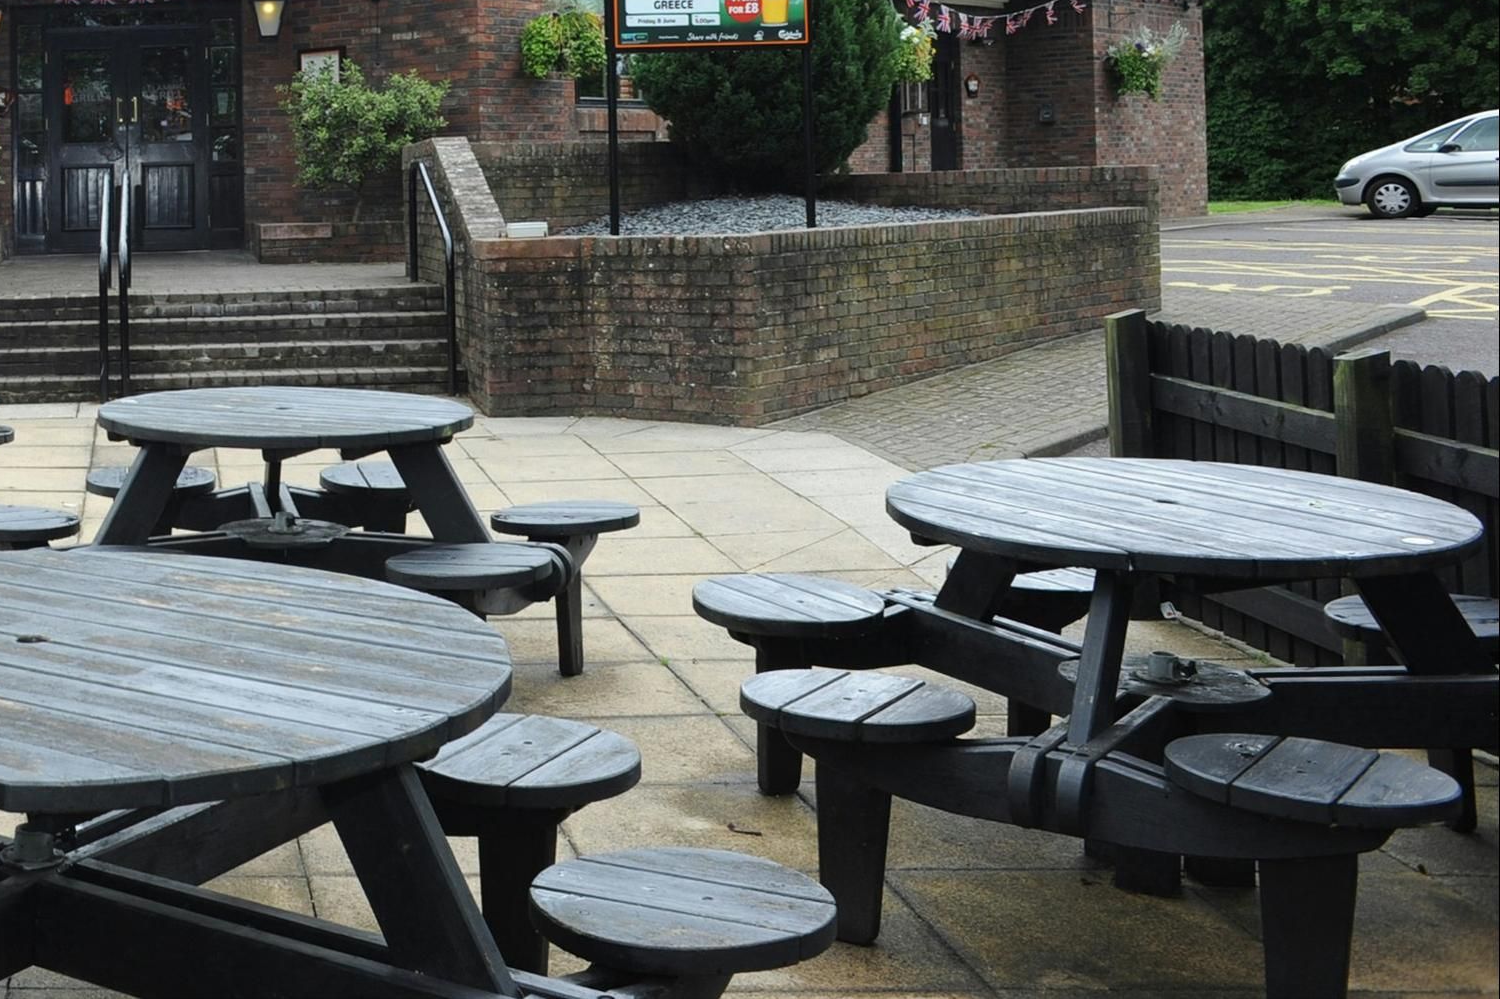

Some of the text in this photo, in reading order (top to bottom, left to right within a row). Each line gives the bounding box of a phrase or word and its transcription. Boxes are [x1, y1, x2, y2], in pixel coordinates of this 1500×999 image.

[654, 0, 694, 10] GREECE
[728, 2, 759, 15] FOR £8
